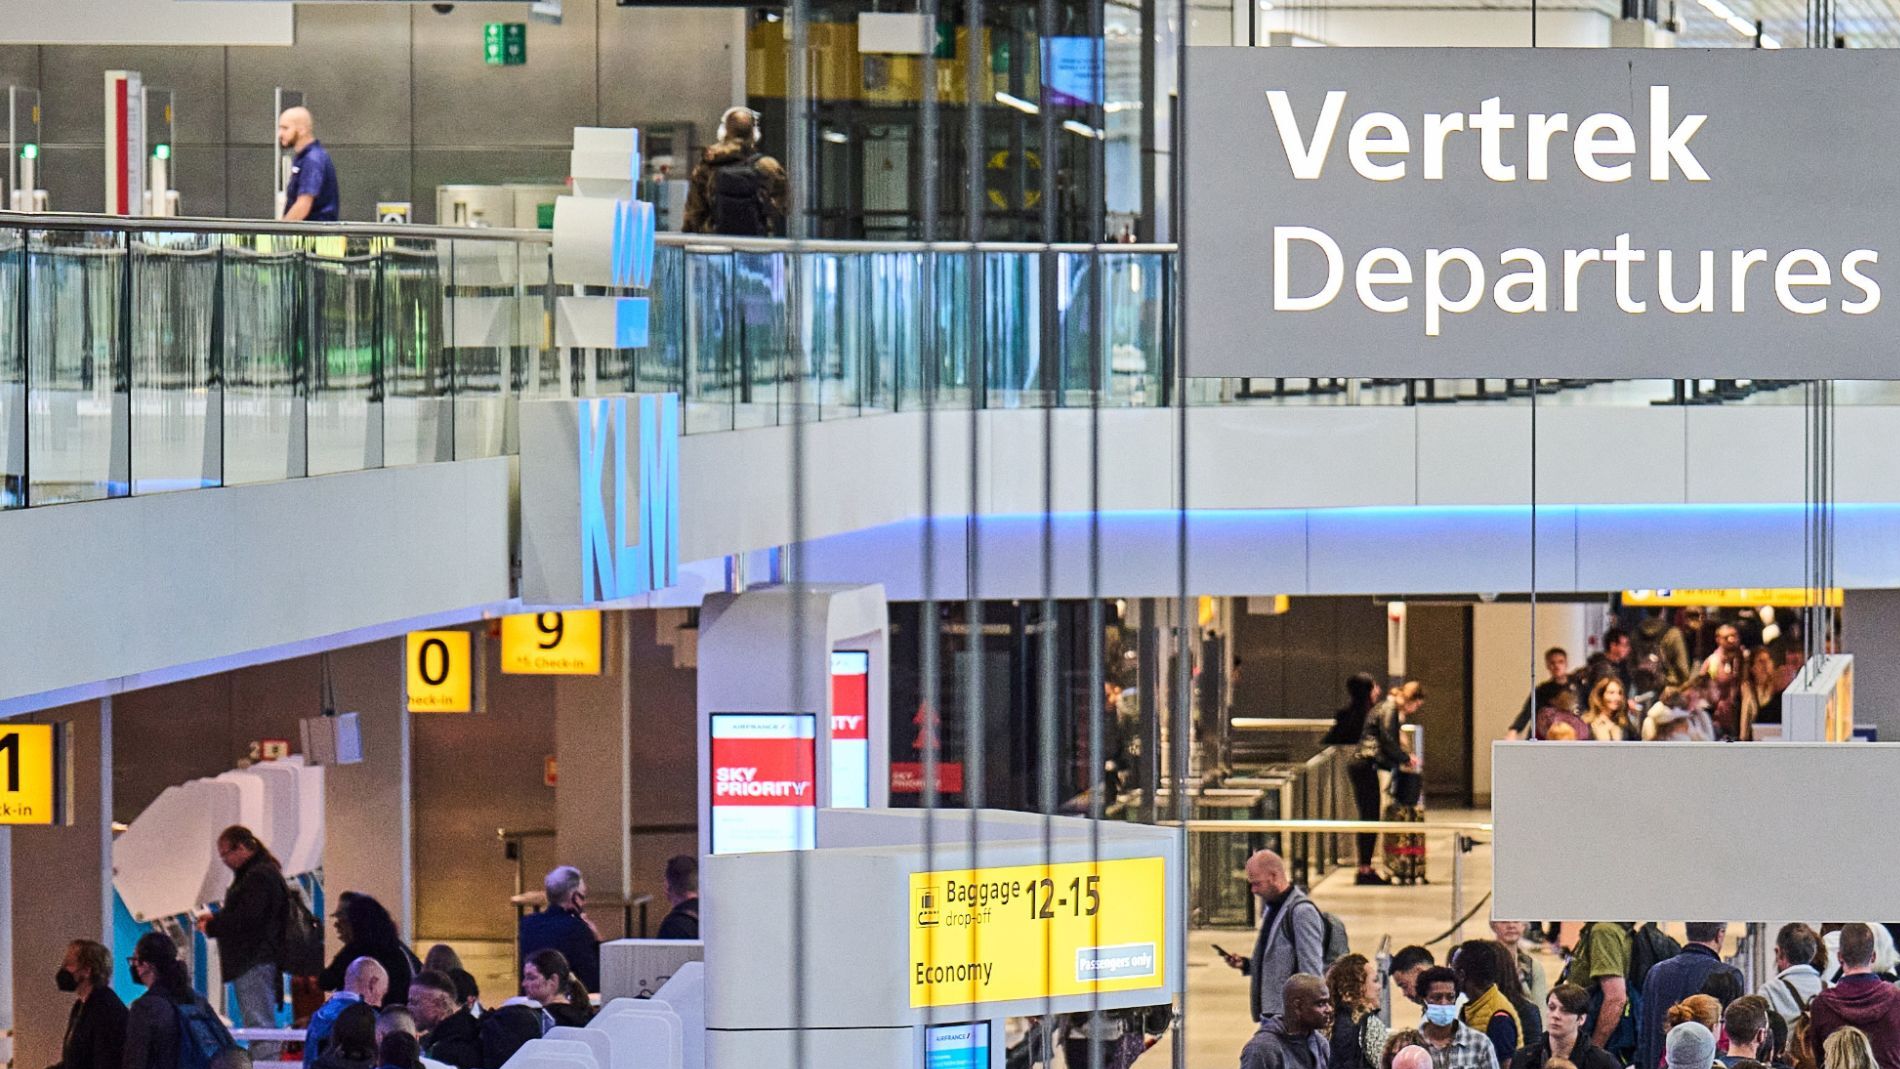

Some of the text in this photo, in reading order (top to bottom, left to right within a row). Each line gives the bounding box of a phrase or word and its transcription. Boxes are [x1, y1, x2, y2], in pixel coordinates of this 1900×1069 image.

[1266, 85, 1711, 182] Vertrek
[1272, 225, 1881, 337] Departures
[579, 393, 679, 605] KLM
[717, 767, 758, 782] SKY
[717, 781, 809, 797] PRIORITY
[946, 875, 1101, 920] Baggage 12-15
[945, 908, 992, 929] drop-off
[915, 960, 993, 987] Economy
[1079, 952, 1153, 973] Passengers only
